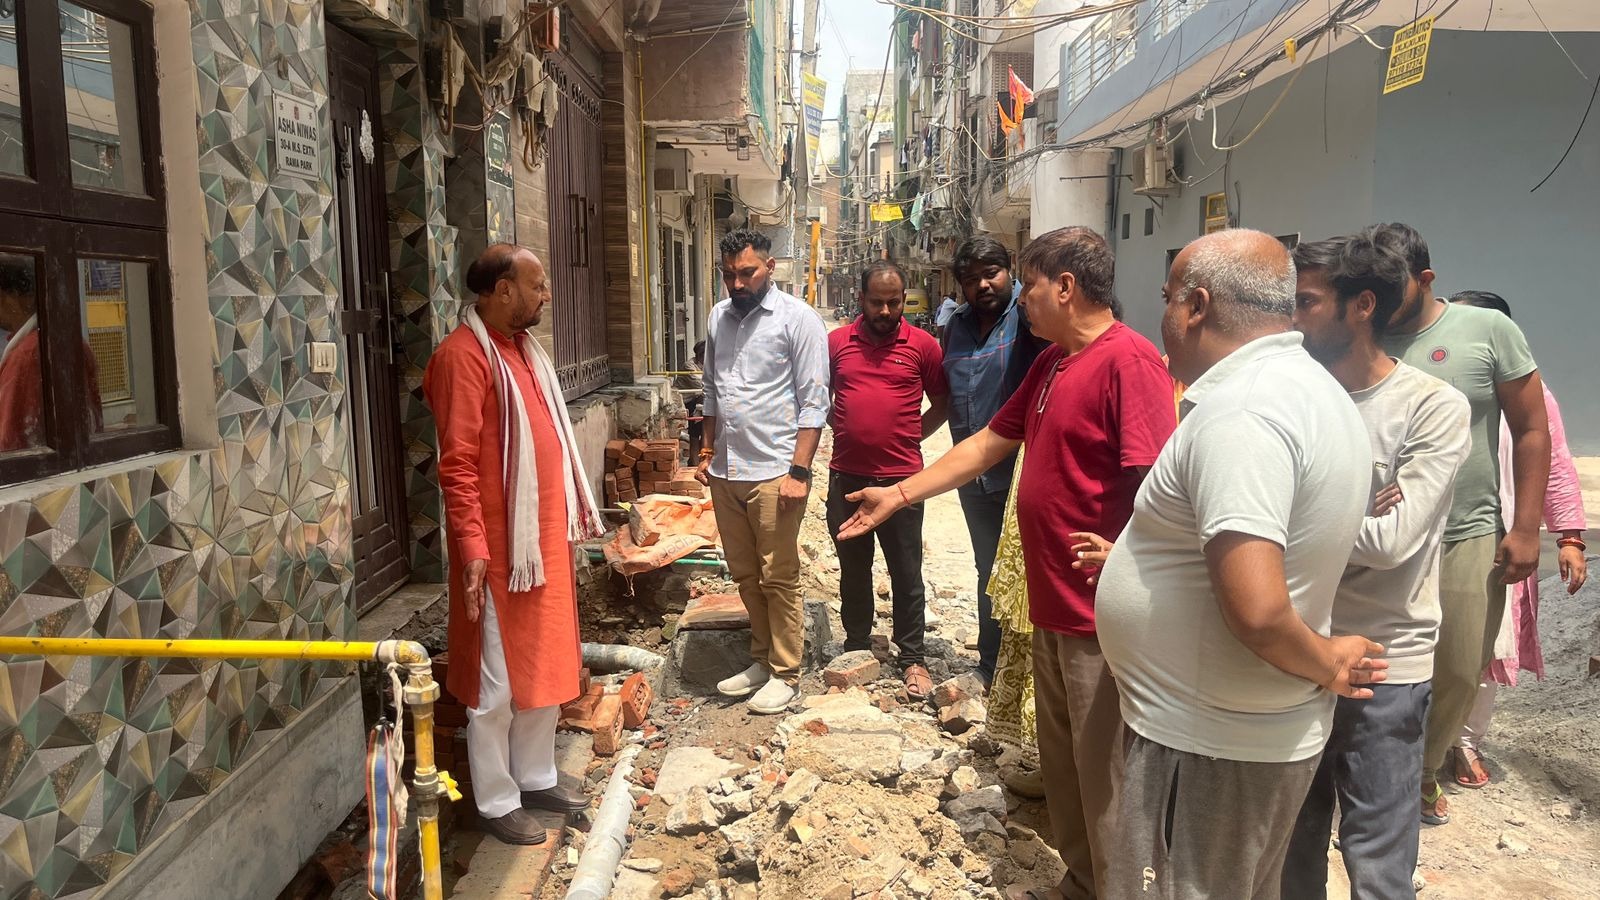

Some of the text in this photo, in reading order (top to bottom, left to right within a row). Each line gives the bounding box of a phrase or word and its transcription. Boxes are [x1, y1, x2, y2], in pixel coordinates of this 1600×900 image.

[1395, 19, 1431, 44] MATHEMATICS
[278, 117, 317, 141] ASHA NIWAS
[285, 156, 312, 171] RAMA PARK
